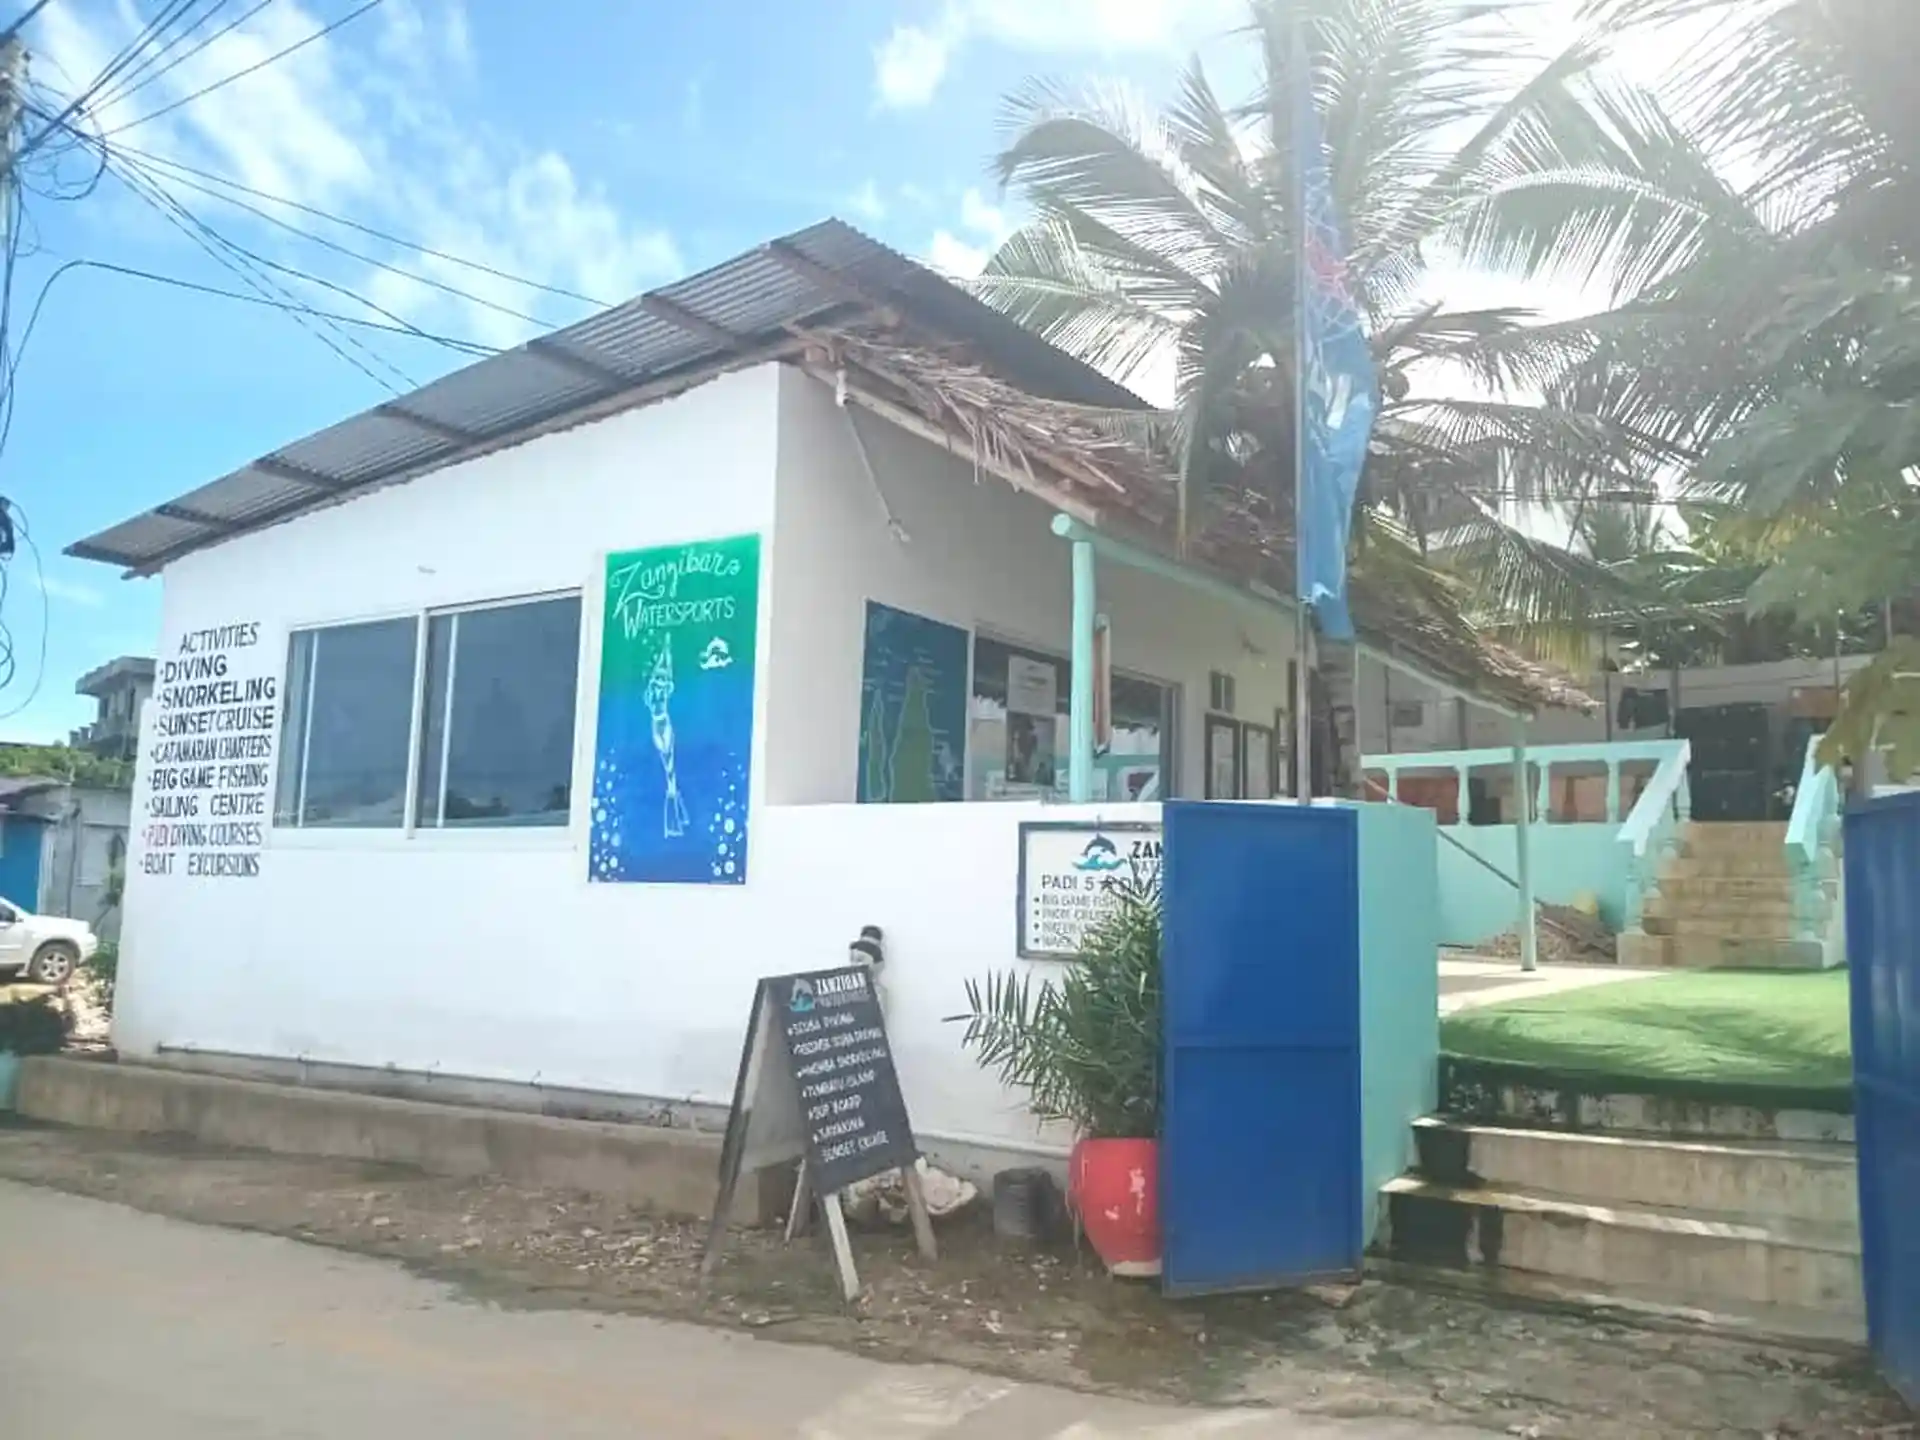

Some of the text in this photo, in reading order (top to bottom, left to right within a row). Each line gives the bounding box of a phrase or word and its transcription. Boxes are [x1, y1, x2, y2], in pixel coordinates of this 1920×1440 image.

[179, 622, 261, 655] ACTIVITIES
[163, 654, 227, 683] DIVING
[161, 676, 276, 710] SNORKELING
[155, 735, 272, 764] CATAMARAN CHARTERS
[152, 763, 269, 792] BIG GAME FISHING
[150, 792, 265, 818] SAILING CENTRE
[170, 822, 207, 847] DIVING
[208, 822, 263, 846] COURSES
[143, 852, 260, 877] BOAT EXCURSIONS
[1041, 874, 1078, 891] PADI
[1084, 876, 1095, 892] 5
